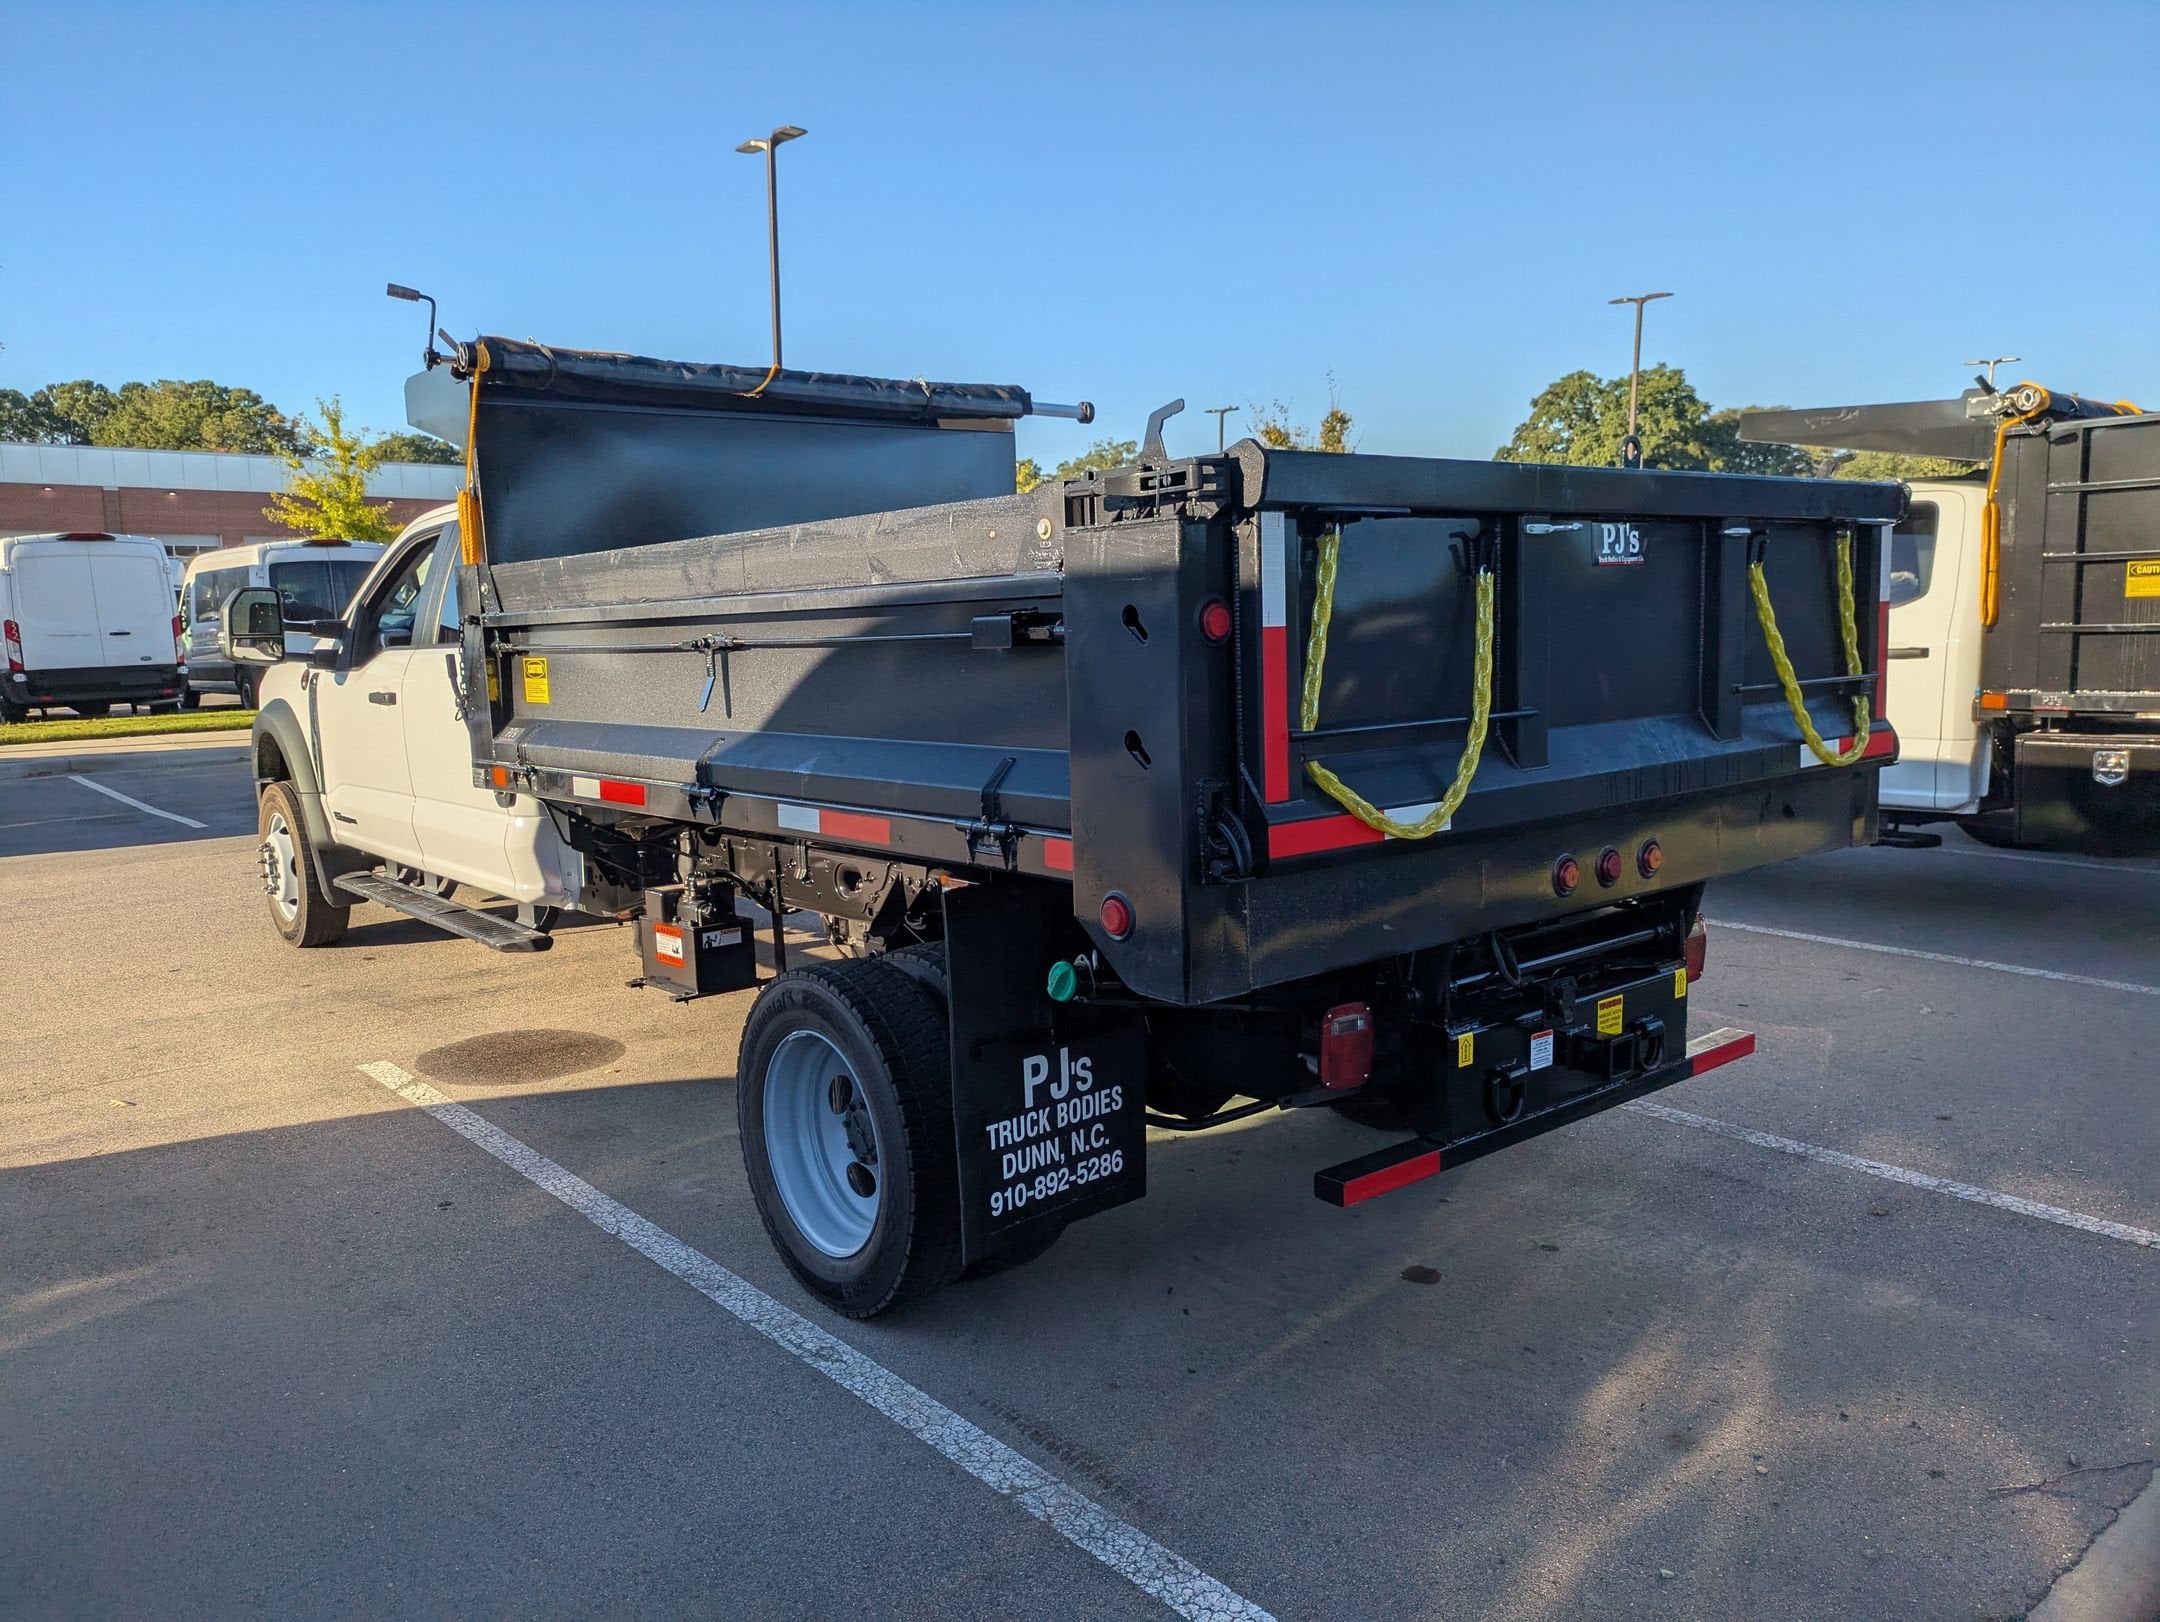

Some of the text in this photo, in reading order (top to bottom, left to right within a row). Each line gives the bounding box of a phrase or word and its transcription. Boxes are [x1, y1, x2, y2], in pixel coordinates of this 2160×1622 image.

[1601, 523, 1640, 554] PJ's
[1023, 1047, 1093, 1109] PJ's
[986, 1085, 1123, 1150] TRUCK BODIES
[1002, 1123, 1110, 1180] DUNN, N.C.
[990, 1149, 1123, 1217] 910-892-5286
